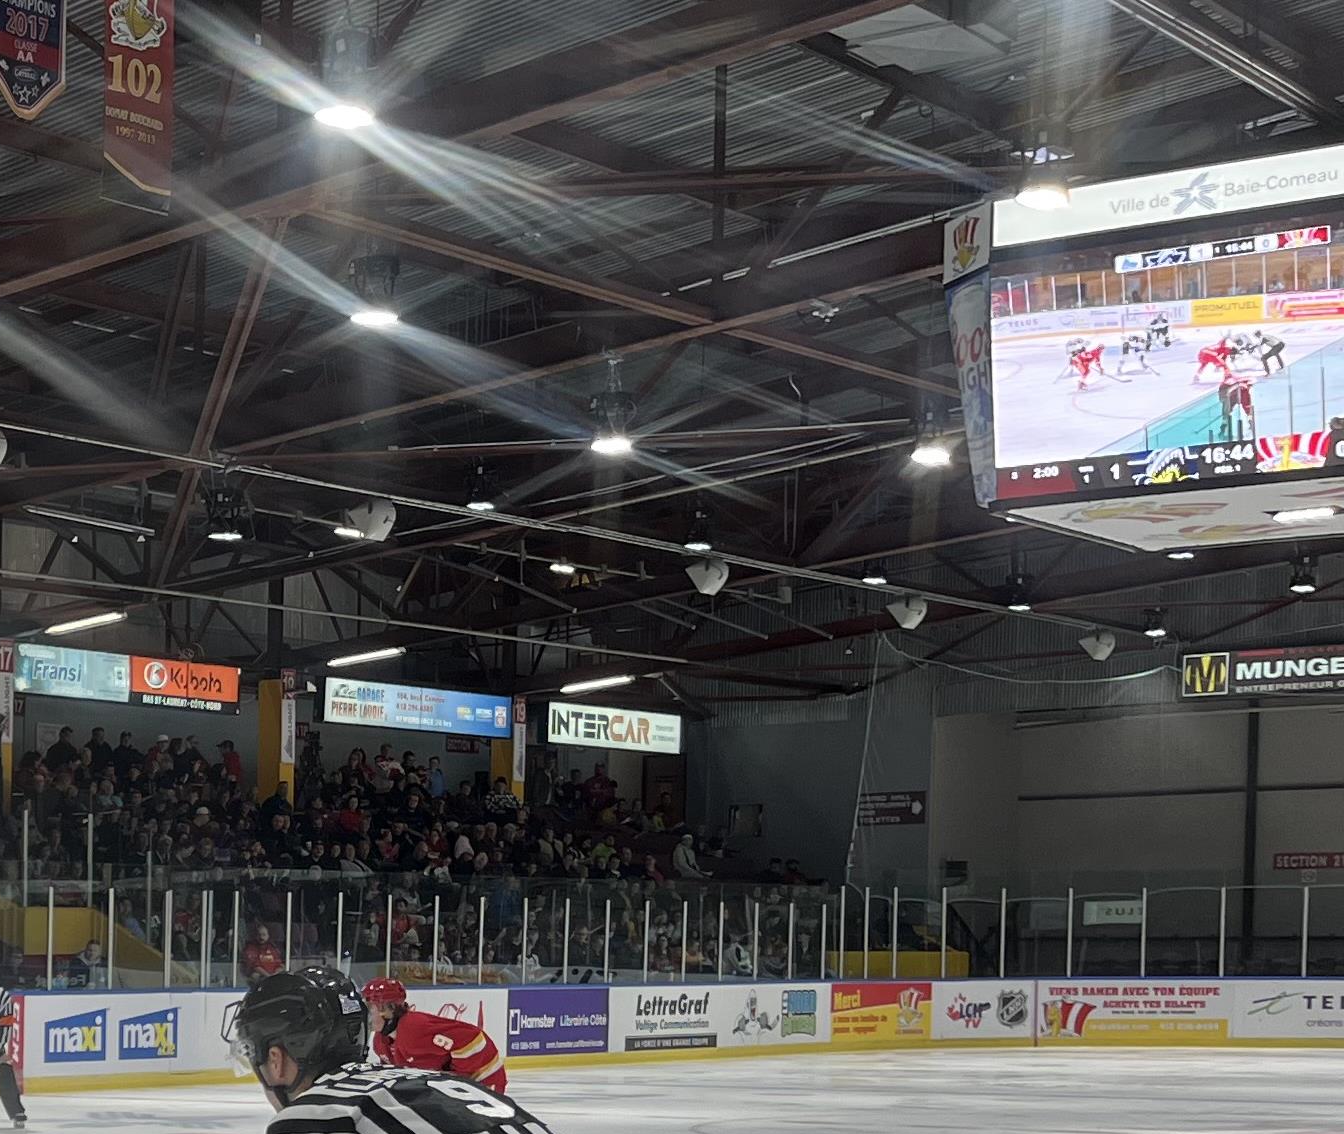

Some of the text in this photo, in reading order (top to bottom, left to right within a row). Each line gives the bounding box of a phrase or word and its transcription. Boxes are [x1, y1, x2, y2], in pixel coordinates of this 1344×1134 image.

[5, 8, 50, 42] 2017
[16, 50, 34, 63] AA
[108, 54, 162, 104] 102
[1110, 169, 1340, 214] Ville de Baie-Comeau
[1192, 299, 1262, 315] PROMUTUEL
[0, 647, 12, 672] 17
[356, 687, 386, 703] GARAGE
[1236, 681, 1334, 694] ENTREPRENEUR
[330, 700, 359, 719] PIERRE
[514, 702, 527, 724] 19
[551, 708, 651, 745] INTERCAR
[833, 989, 861, 1011] Merci
[1048, 984, 1221, 997] VIENS RAMER AVEC TON ÉQUIPE
[636, 991, 711, 1017] LettraGraf
[122, 1011, 176, 1051] maxi
[520, 1012, 608, 1029] Hamster Librairie Côté
[659, 1017, 710, 1030] Communication
[964, 1018, 981, 1029] TV
[48, 1014, 103, 1054] maxi
[432, 1033, 454, 1051] 9
[426, 1079, 516, 1119] 9
